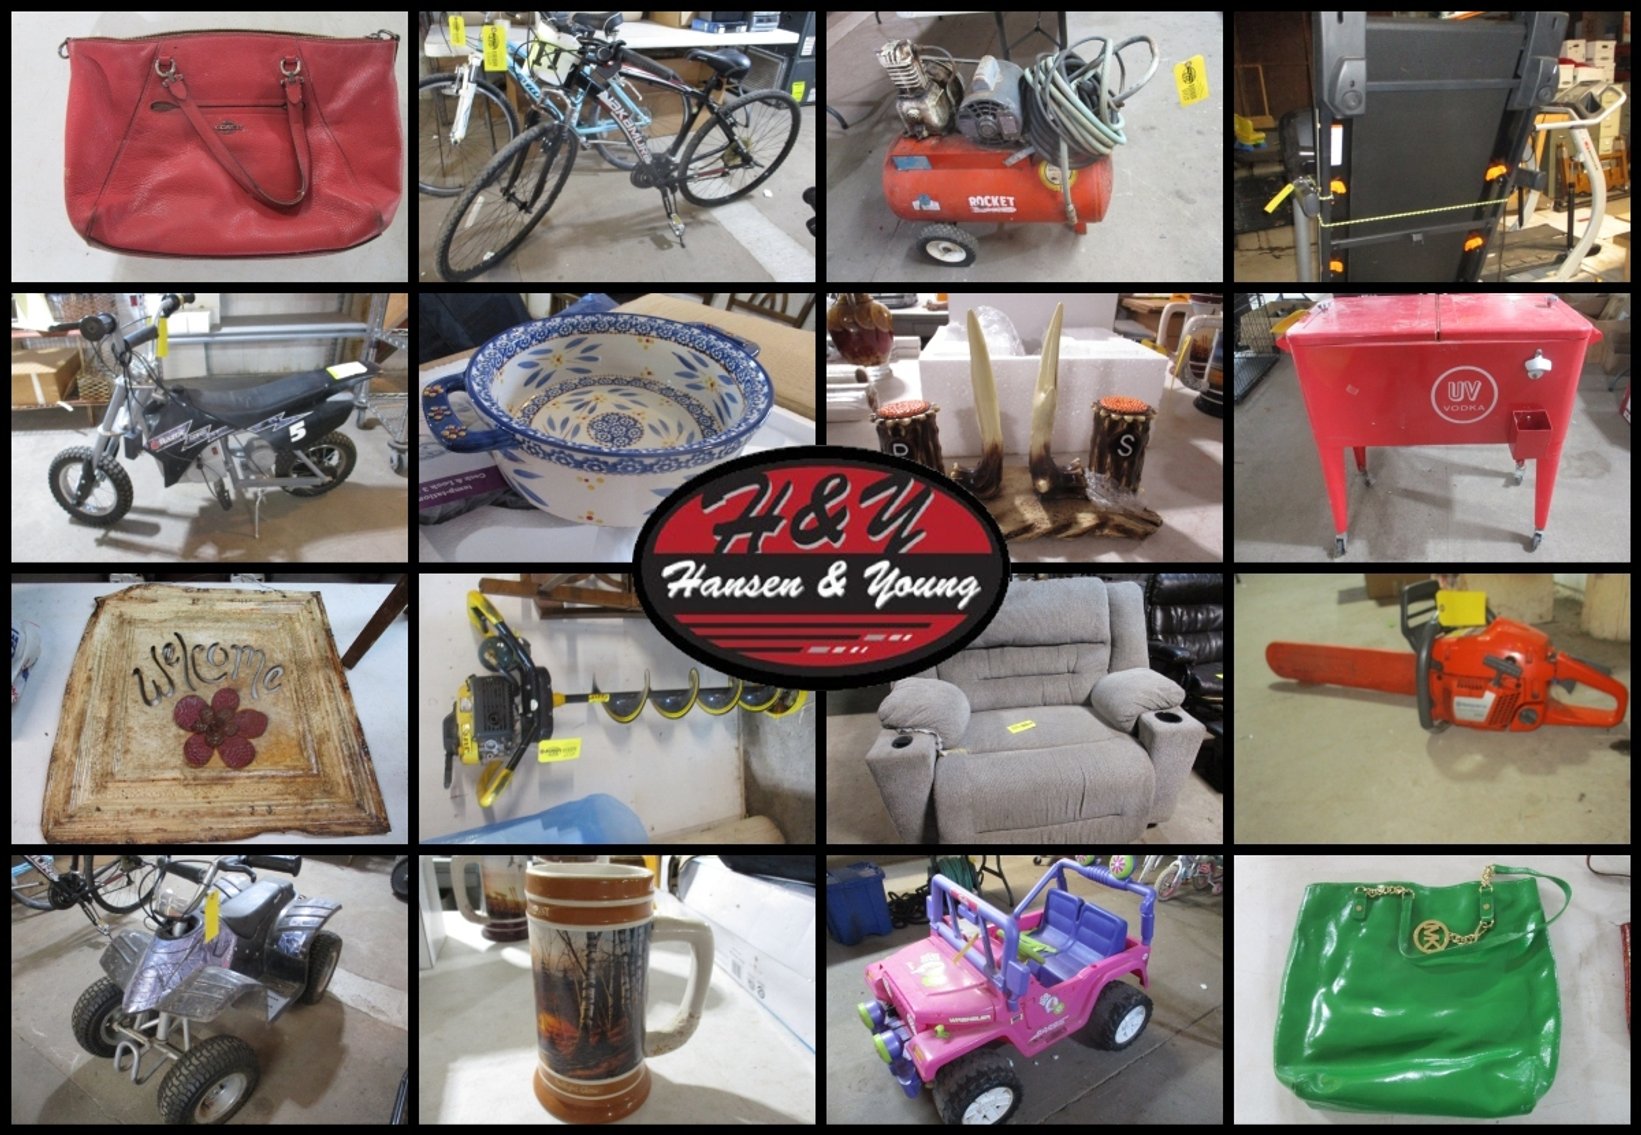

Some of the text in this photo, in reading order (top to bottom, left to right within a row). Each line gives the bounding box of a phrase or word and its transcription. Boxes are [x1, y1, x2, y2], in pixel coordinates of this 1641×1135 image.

[968, 195, 1015, 207] ROCKET
[1448, 381, 1482, 401] UV
[289, 420, 307, 443] 5
[1117, 434, 1135, 456] S
[132, 631, 285, 707] Welcome
